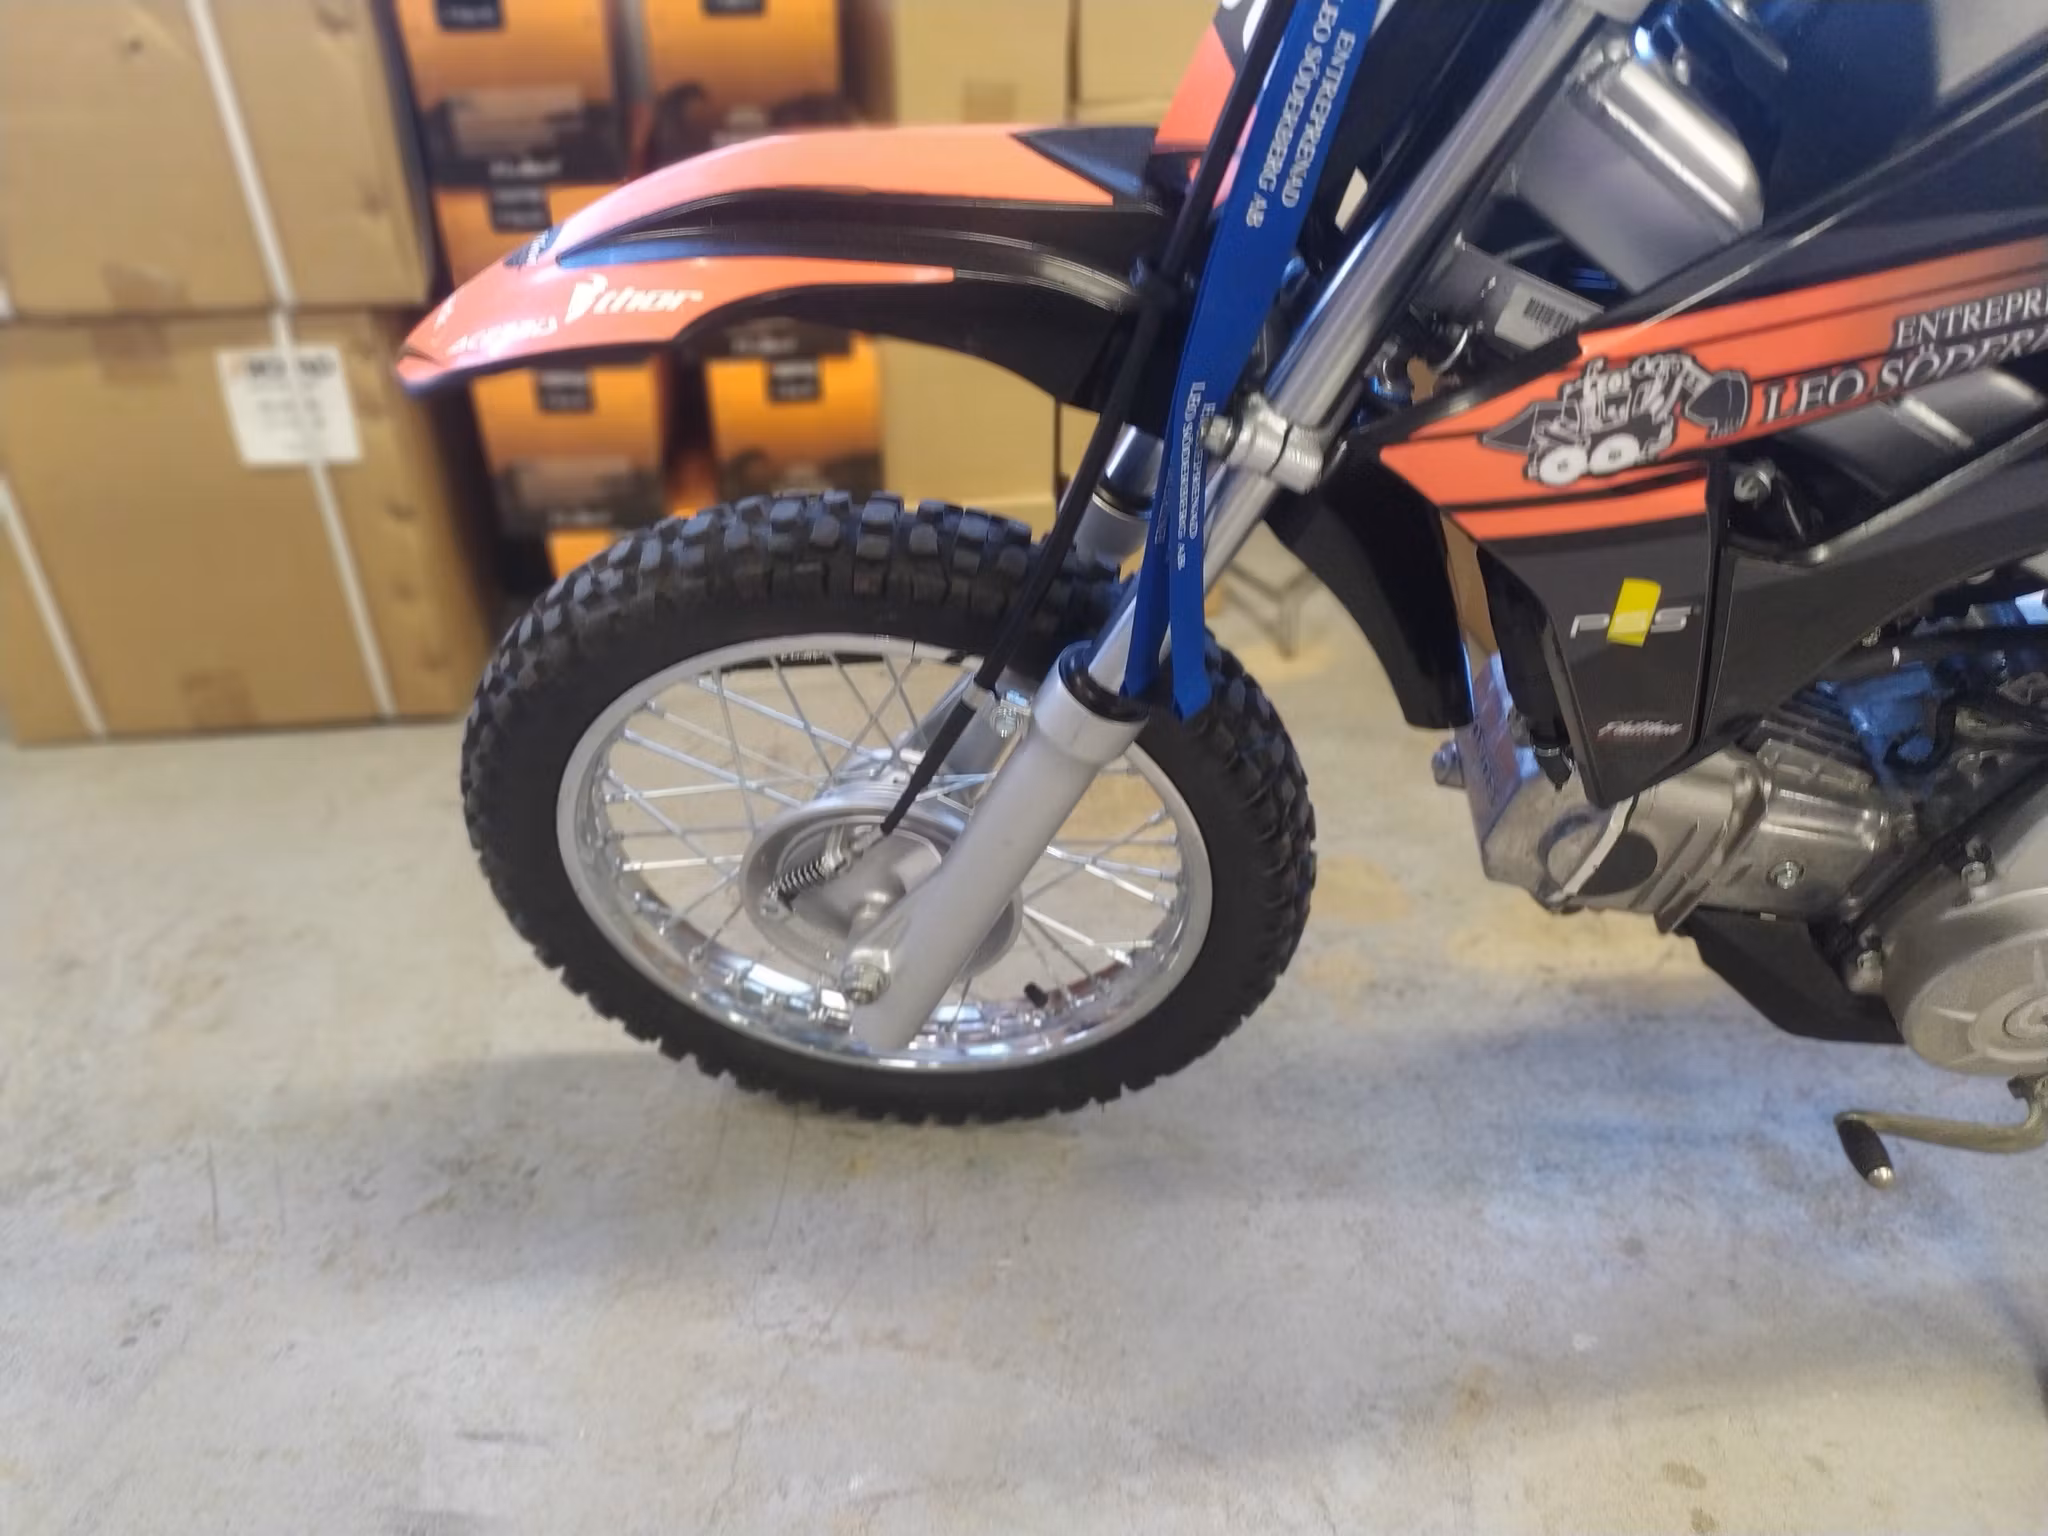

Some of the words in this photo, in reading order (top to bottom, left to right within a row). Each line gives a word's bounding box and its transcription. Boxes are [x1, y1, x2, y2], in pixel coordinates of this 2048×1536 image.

[1246, 192, 1268, 228] AB
[1896, 284, 2048, 349] ENTREPR
[1185, 382, 1206, 422] LEO
[1766, 368, 1866, 423] LEO
